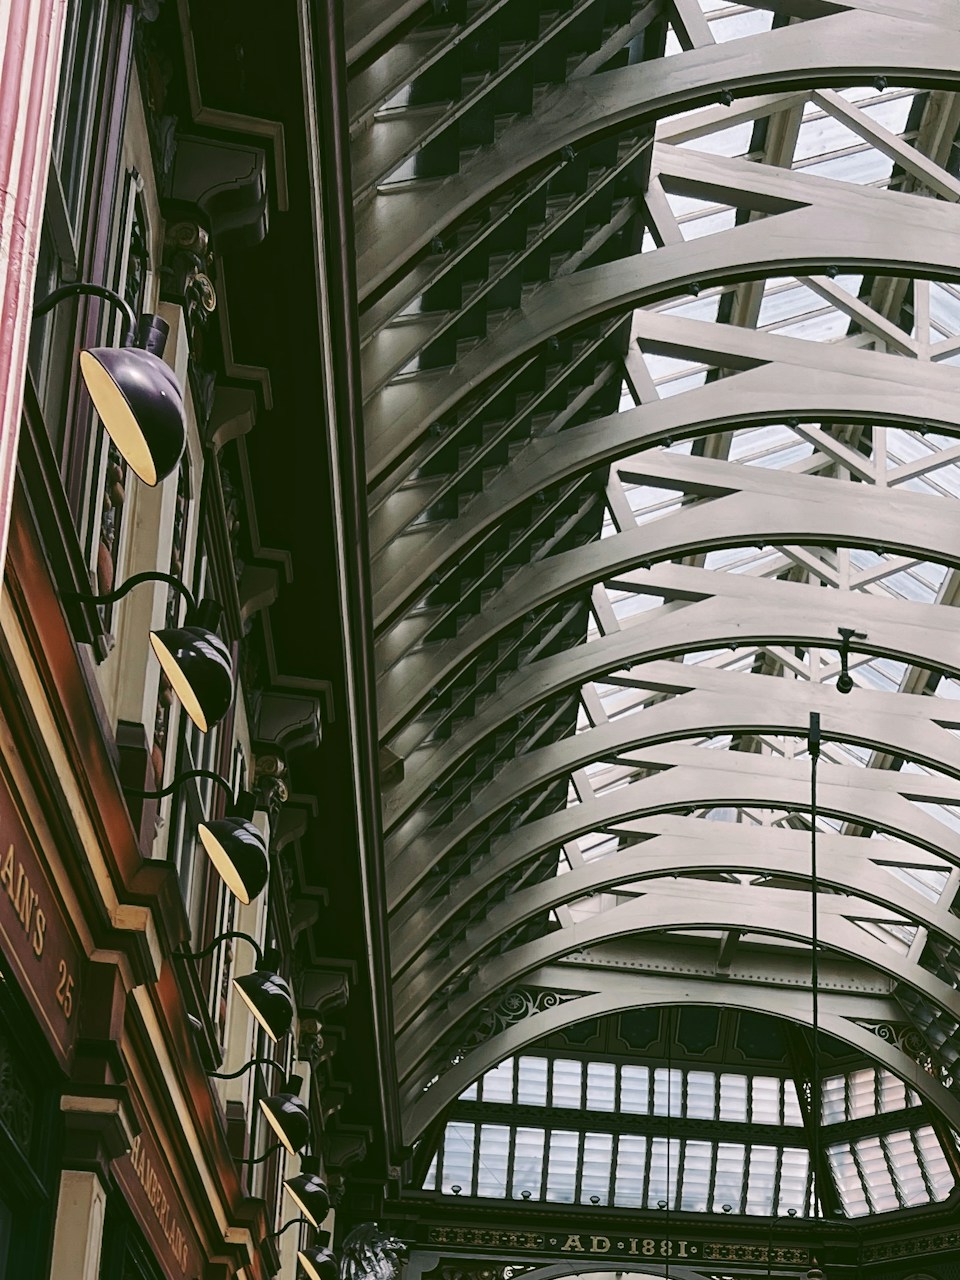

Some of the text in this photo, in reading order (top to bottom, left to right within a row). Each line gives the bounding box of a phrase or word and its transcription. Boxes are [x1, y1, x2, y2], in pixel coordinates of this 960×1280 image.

[0, 844, 74, 1018] AIN'S 25
[629, 1238, 688, 1257] 1881
